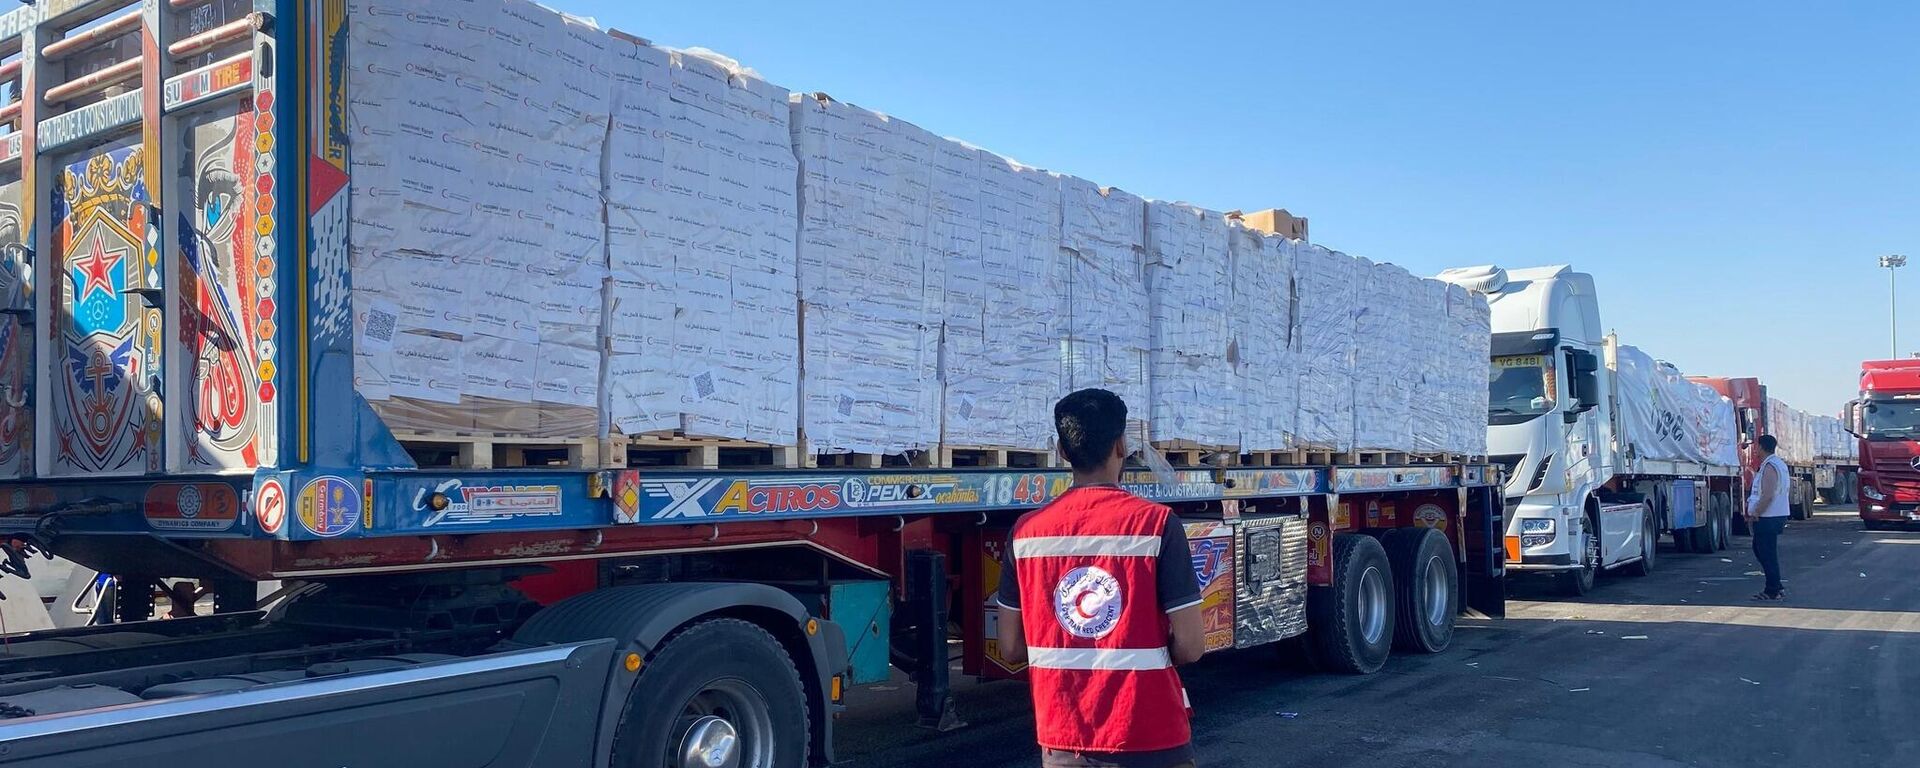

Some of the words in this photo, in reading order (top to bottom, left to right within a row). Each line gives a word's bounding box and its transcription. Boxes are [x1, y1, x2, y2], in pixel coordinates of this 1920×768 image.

[216, 62, 240, 88] TIRE
[53, 113, 75, 145] TRADE
[77, 110, 83, 137] &
[84, 91, 143, 135] CONSTRUCTION
[867, 476, 931, 485] COMMERCIAL
[982, 473, 1047, 506] 1843
[1129, 484, 1154, 498] TRADE
[1155, 483, 1161, 497] &
[317, 485, 326, 529] Germany
[1061, 603, 1082, 632] EGYPTIAN
[1082, 626, 1094, 634] RED
[1094, 605, 1115, 633] CRESCENT
